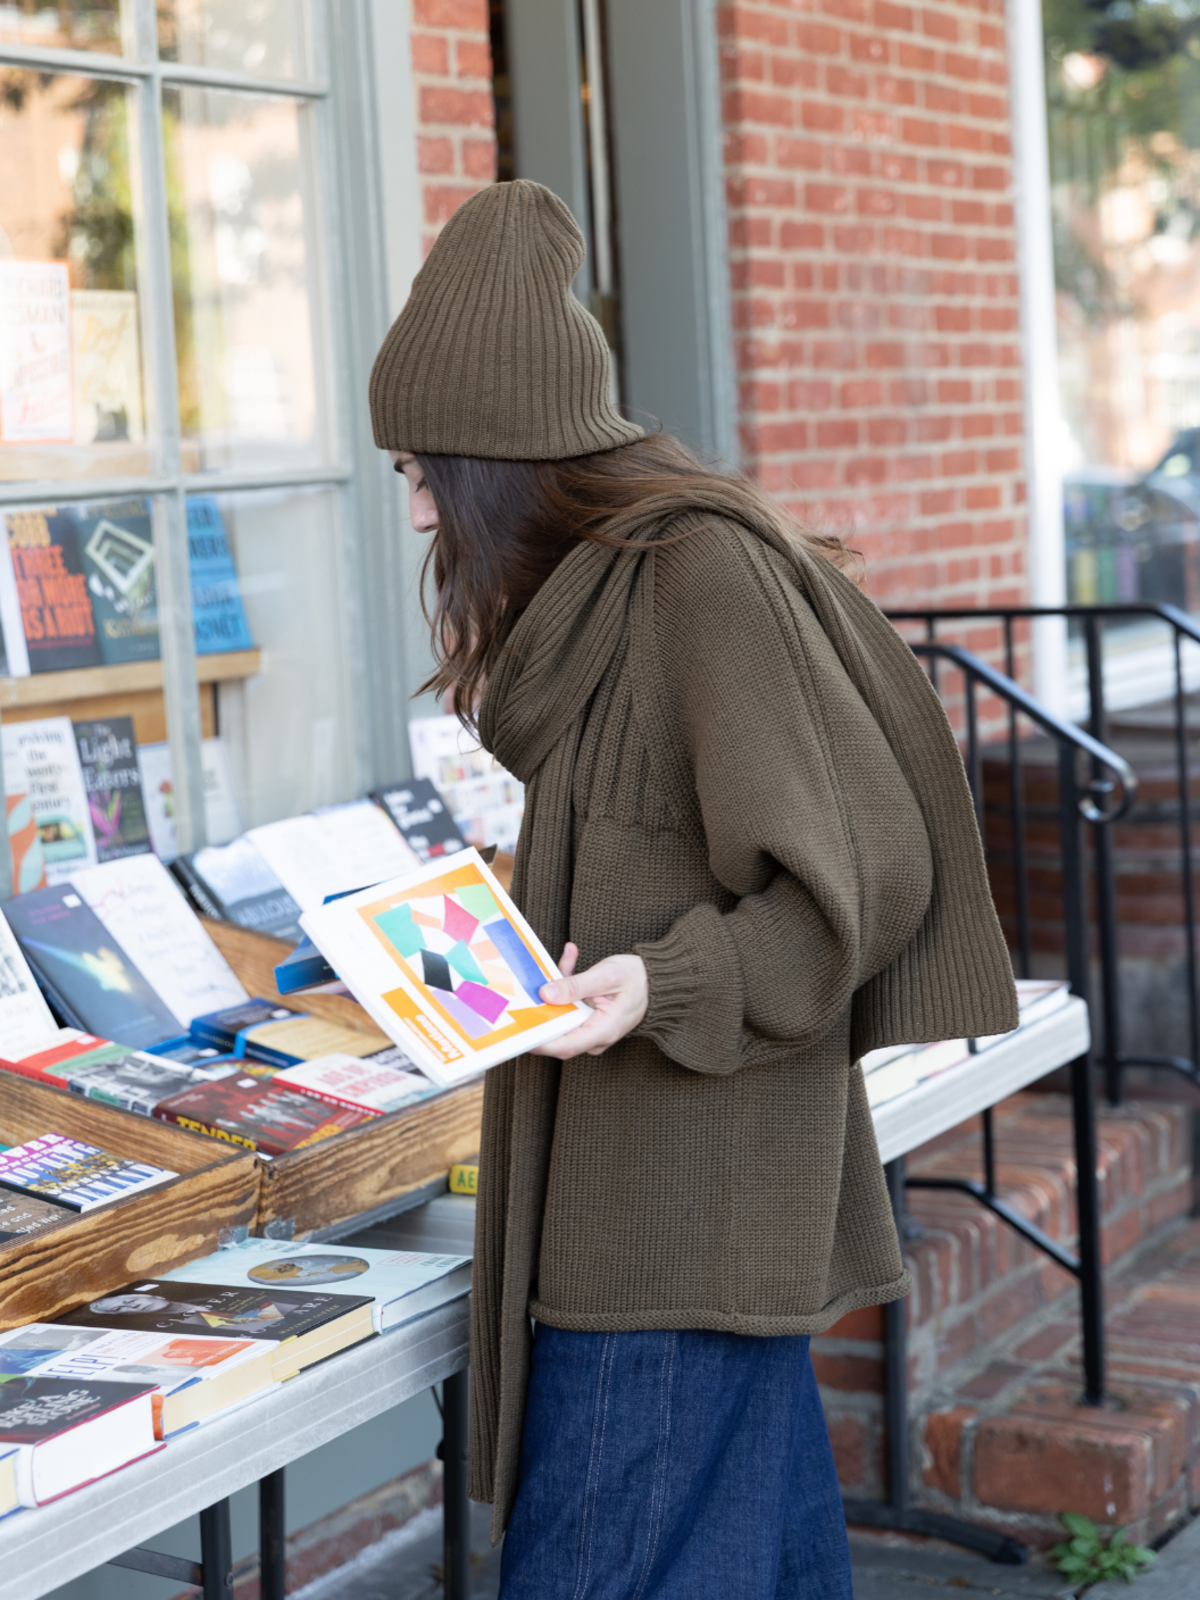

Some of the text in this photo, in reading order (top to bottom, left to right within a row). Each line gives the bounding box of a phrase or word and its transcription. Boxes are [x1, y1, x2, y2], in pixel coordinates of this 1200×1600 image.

[80, 734, 132, 768] Light
[415, 1014, 461, 1059] Matisse
[293, 1297, 334, 1315] ARE
[38, 1353, 127, 1380] HELP!
